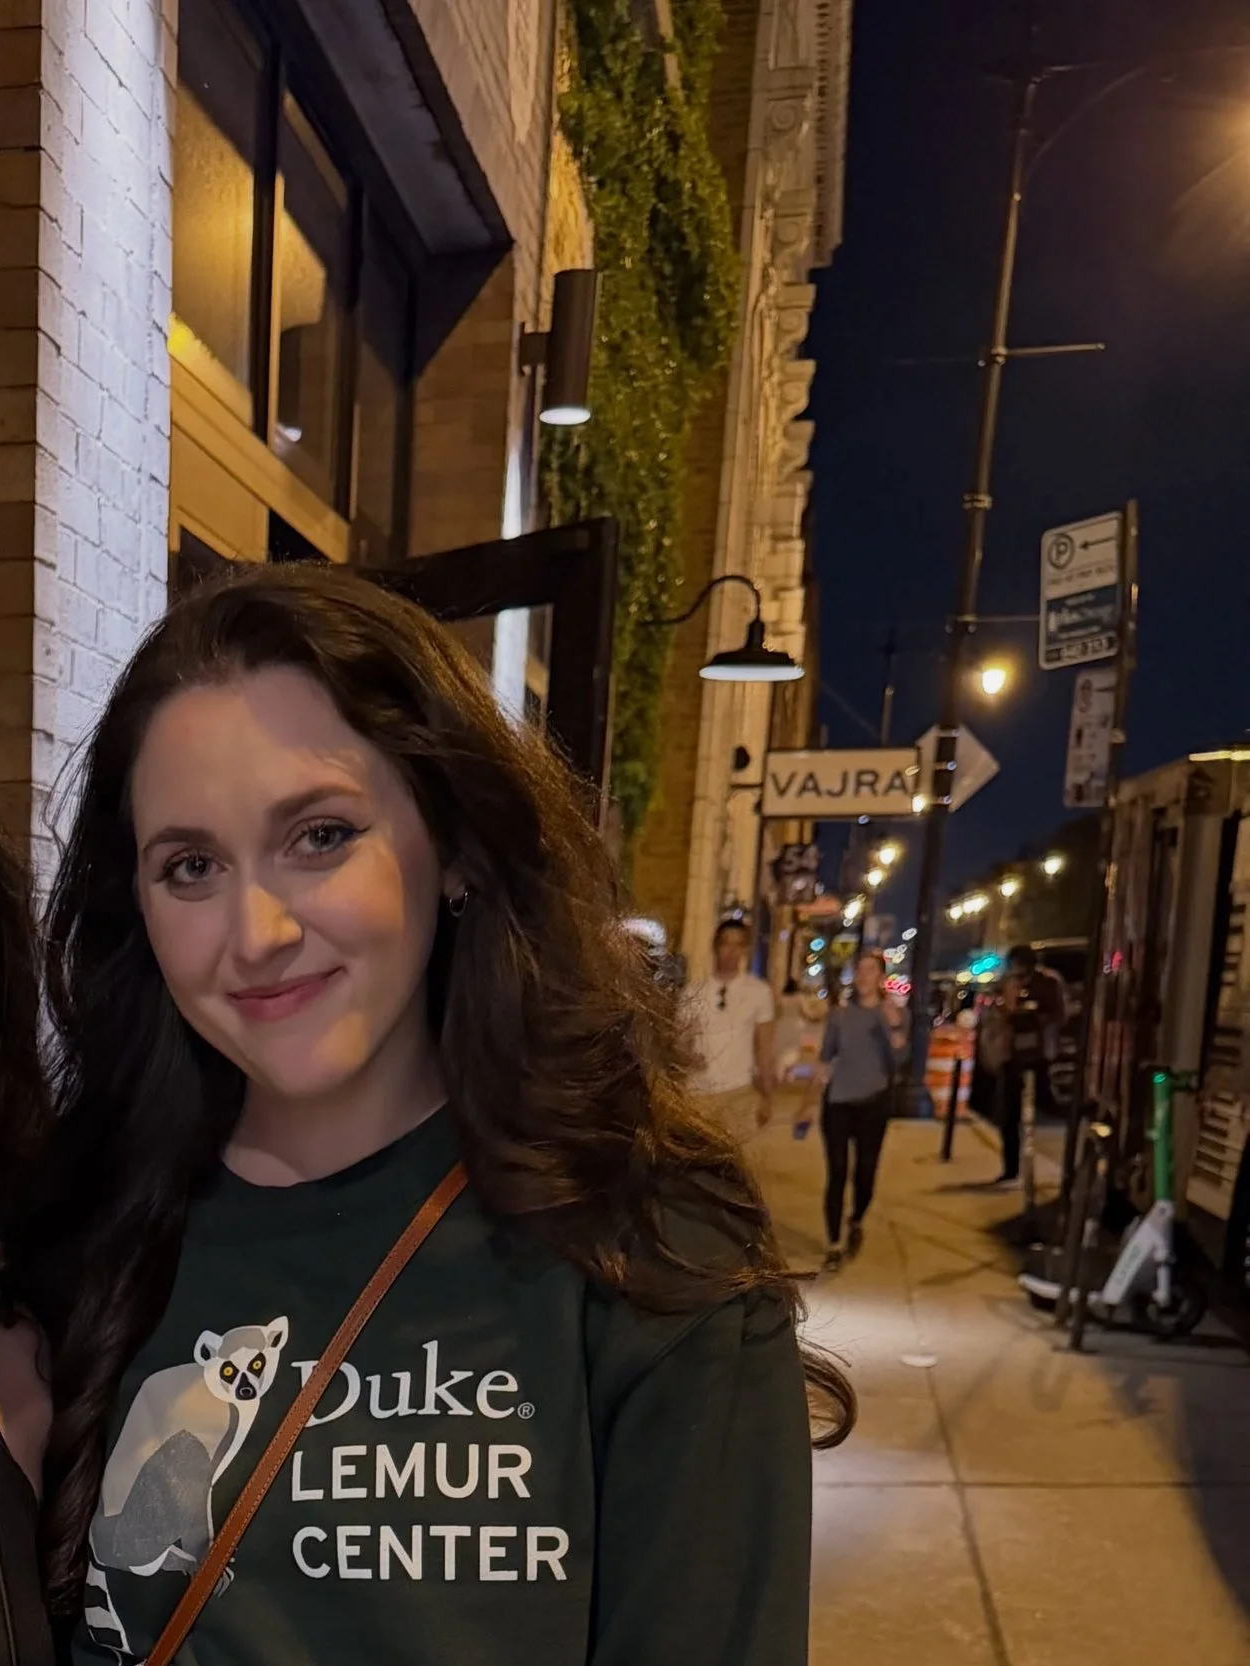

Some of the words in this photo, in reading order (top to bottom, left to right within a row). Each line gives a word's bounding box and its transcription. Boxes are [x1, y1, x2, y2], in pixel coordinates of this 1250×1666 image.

[771, 769, 909, 797] VAJRA
[291, 1442, 533, 1501] LEMUR
[292, 1524, 569, 1581] CENTER
